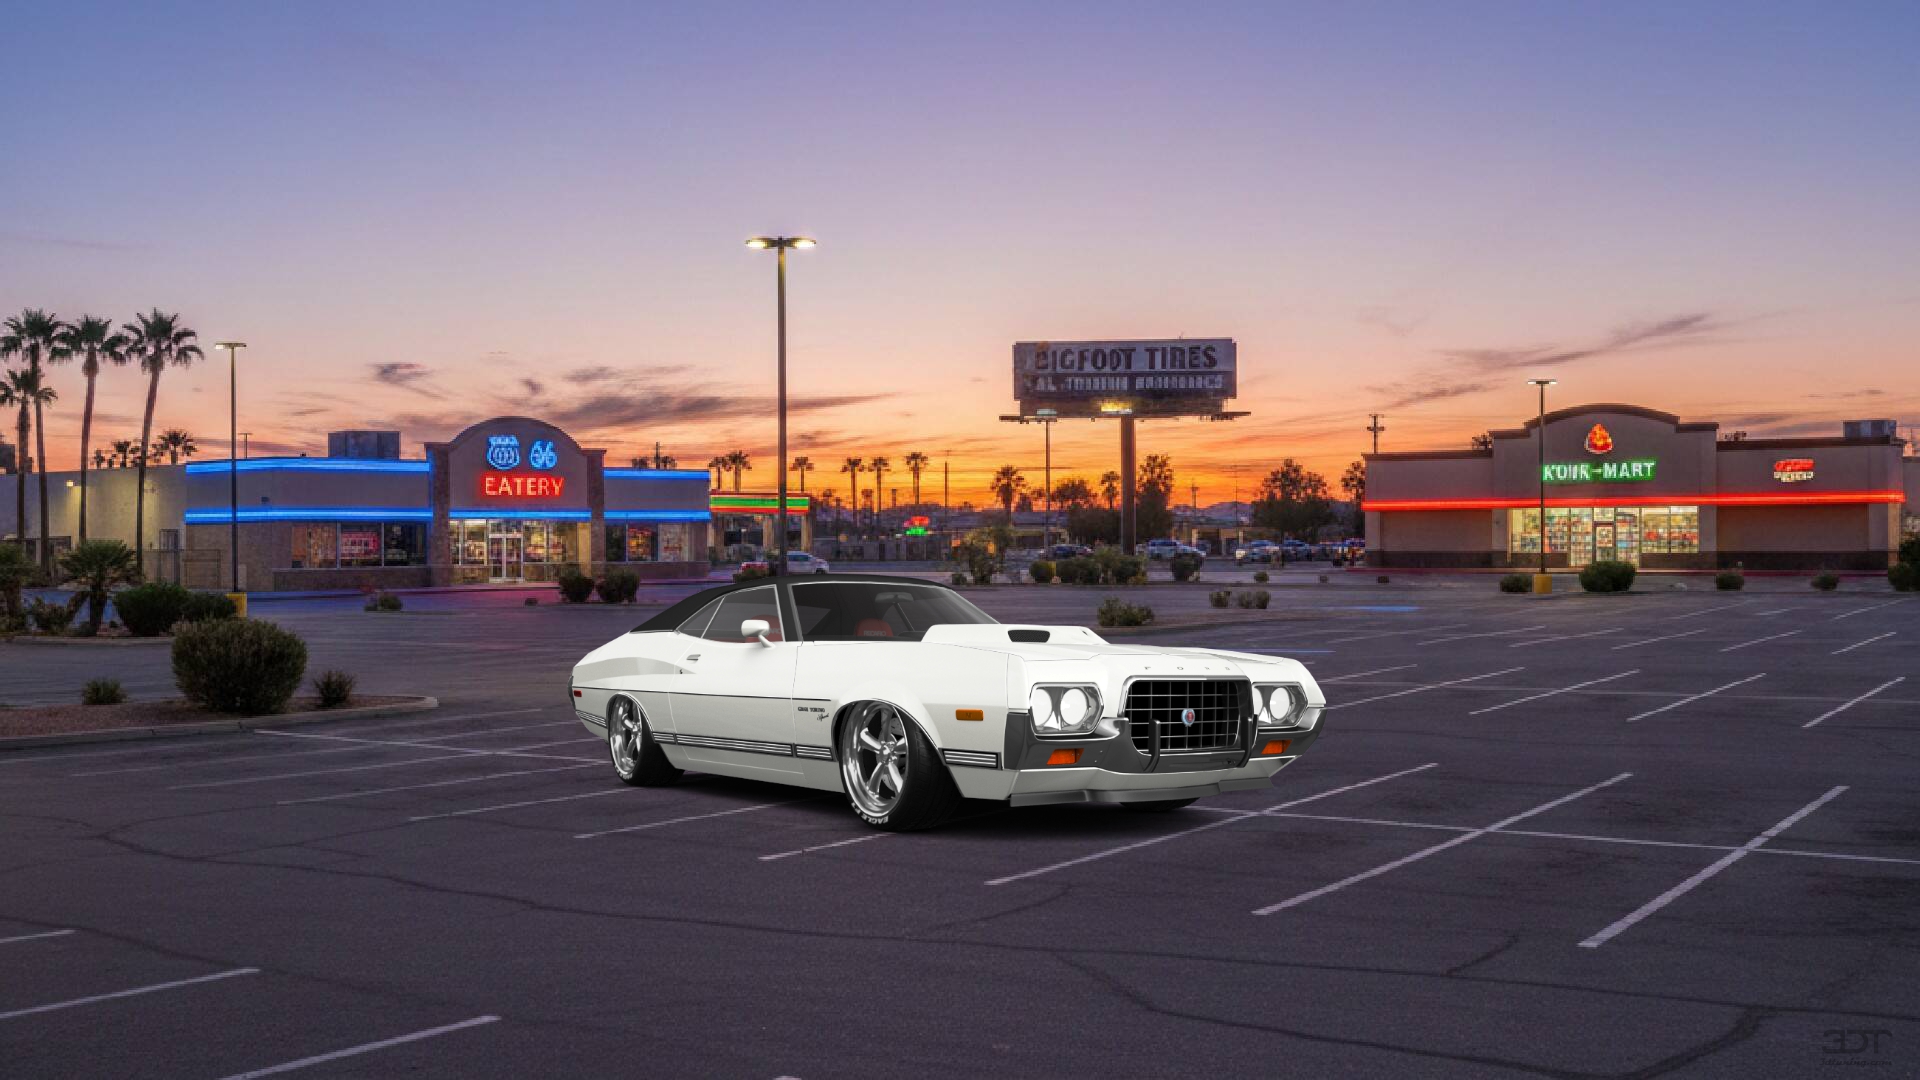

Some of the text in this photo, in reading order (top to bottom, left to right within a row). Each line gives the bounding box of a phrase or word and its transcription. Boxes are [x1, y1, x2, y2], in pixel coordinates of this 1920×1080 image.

[1034, 346, 1218, 371] BIGFOOT TIRES
[485, 477, 564, 496] EATERY
